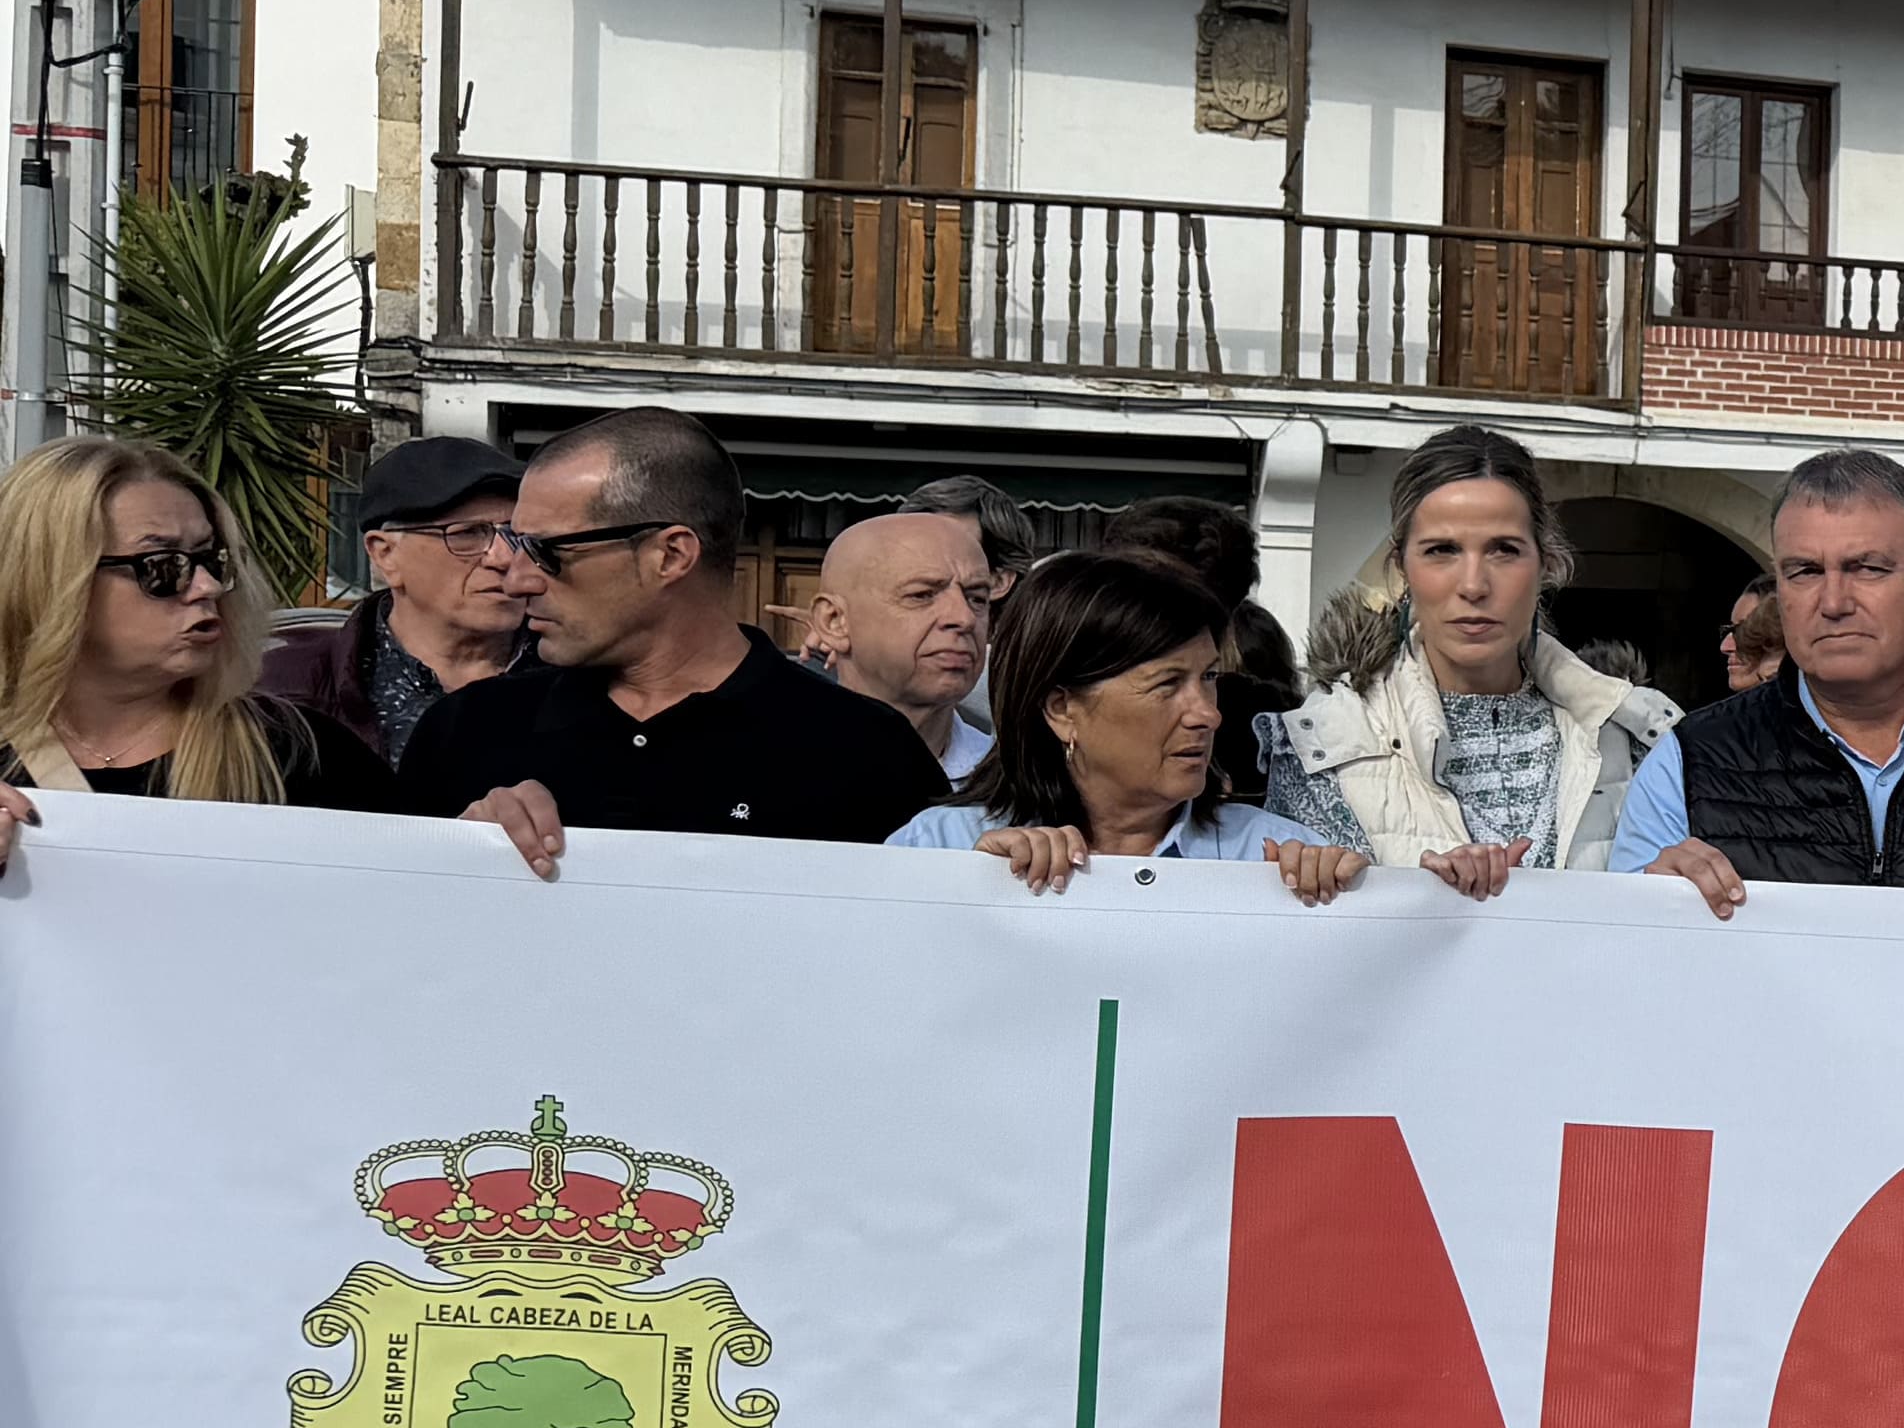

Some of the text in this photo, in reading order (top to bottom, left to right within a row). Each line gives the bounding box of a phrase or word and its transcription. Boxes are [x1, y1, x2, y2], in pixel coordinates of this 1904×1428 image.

[425, 1303, 654, 1331] LEAL CABEZA DE LA
[383, 1332, 408, 1426] SIEMPRE
